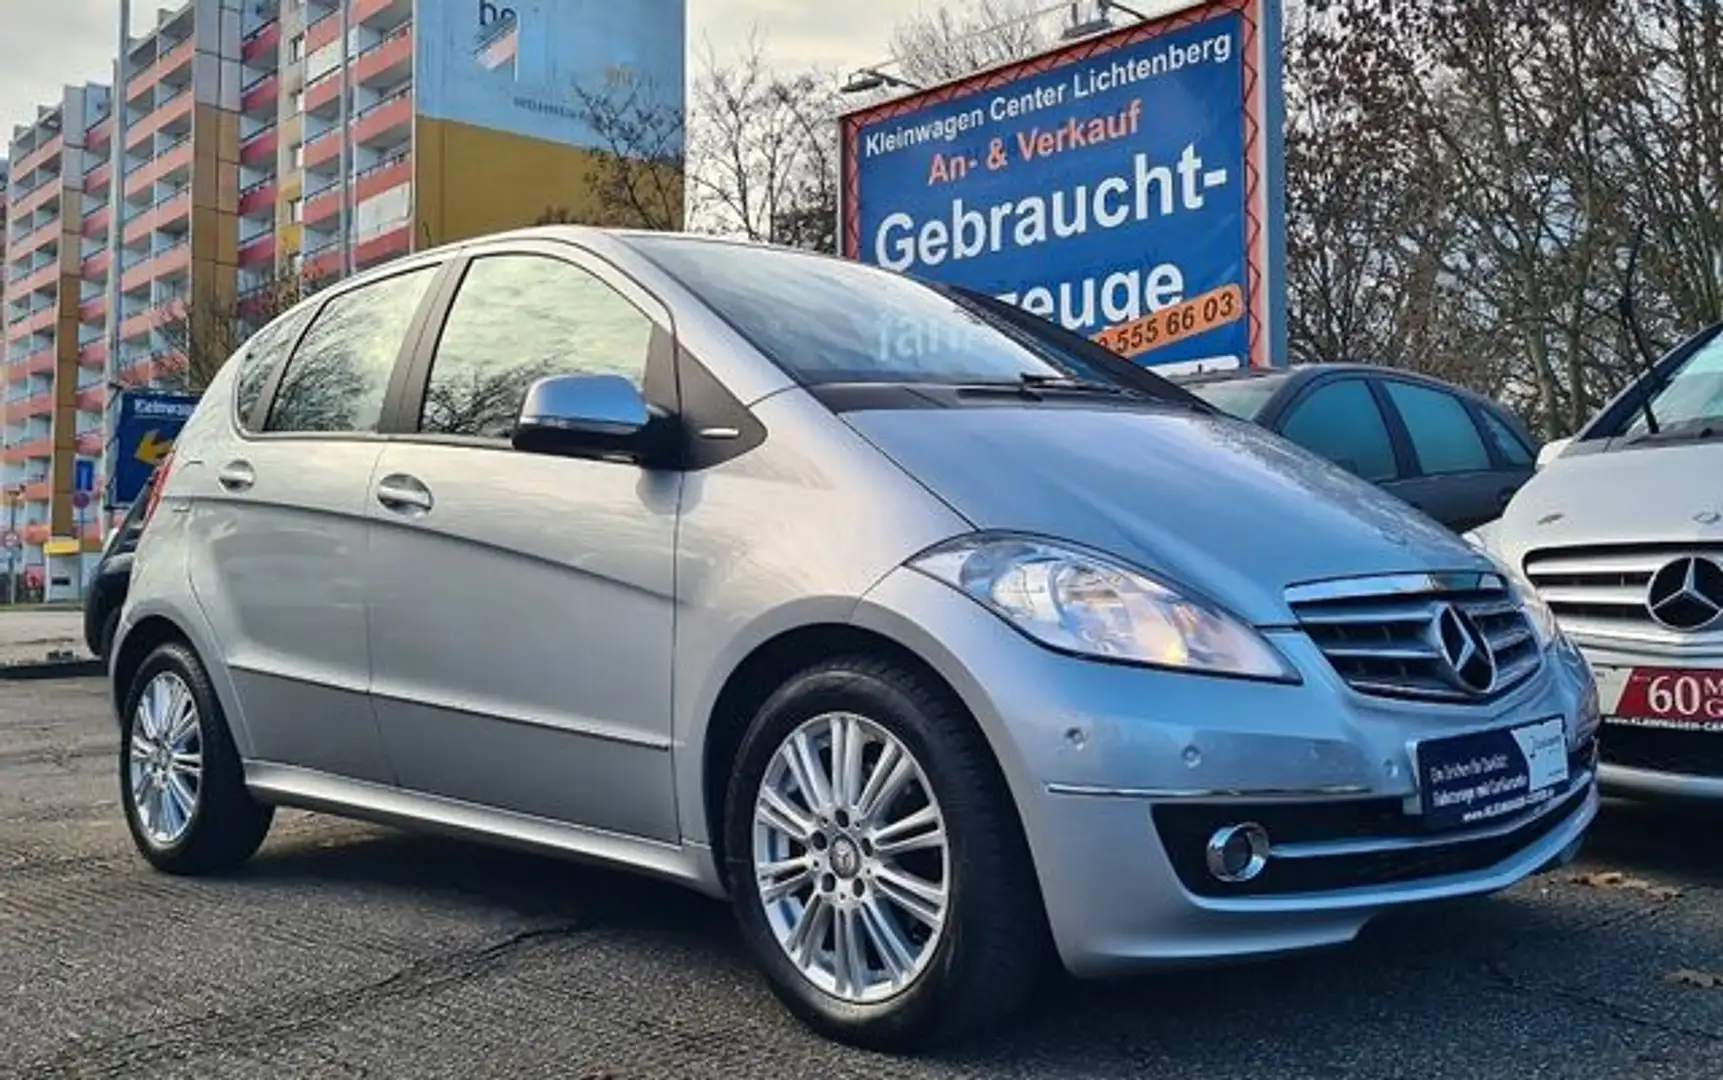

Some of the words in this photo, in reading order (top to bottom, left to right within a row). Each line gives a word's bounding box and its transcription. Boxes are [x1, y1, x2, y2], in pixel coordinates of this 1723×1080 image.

[866, 109, 984, 157] Kleinwagen
[990, 82, 1067, 122] Center
[1073, 32, 1232, 99] Lichtenberg
[928, 152, 978, 186] An-
[986, 138, 1008, 170] &
[1017, 99, 1143, 161] Verkauf
[875, 142, 1228, 272] Gebraucht-
[1114, 317, 1159, 353] 555
[1166, 304, 1194, 336] 66
[1203, 291, 1235, 321] 03
[1648, 676, 1701, 715] 60
